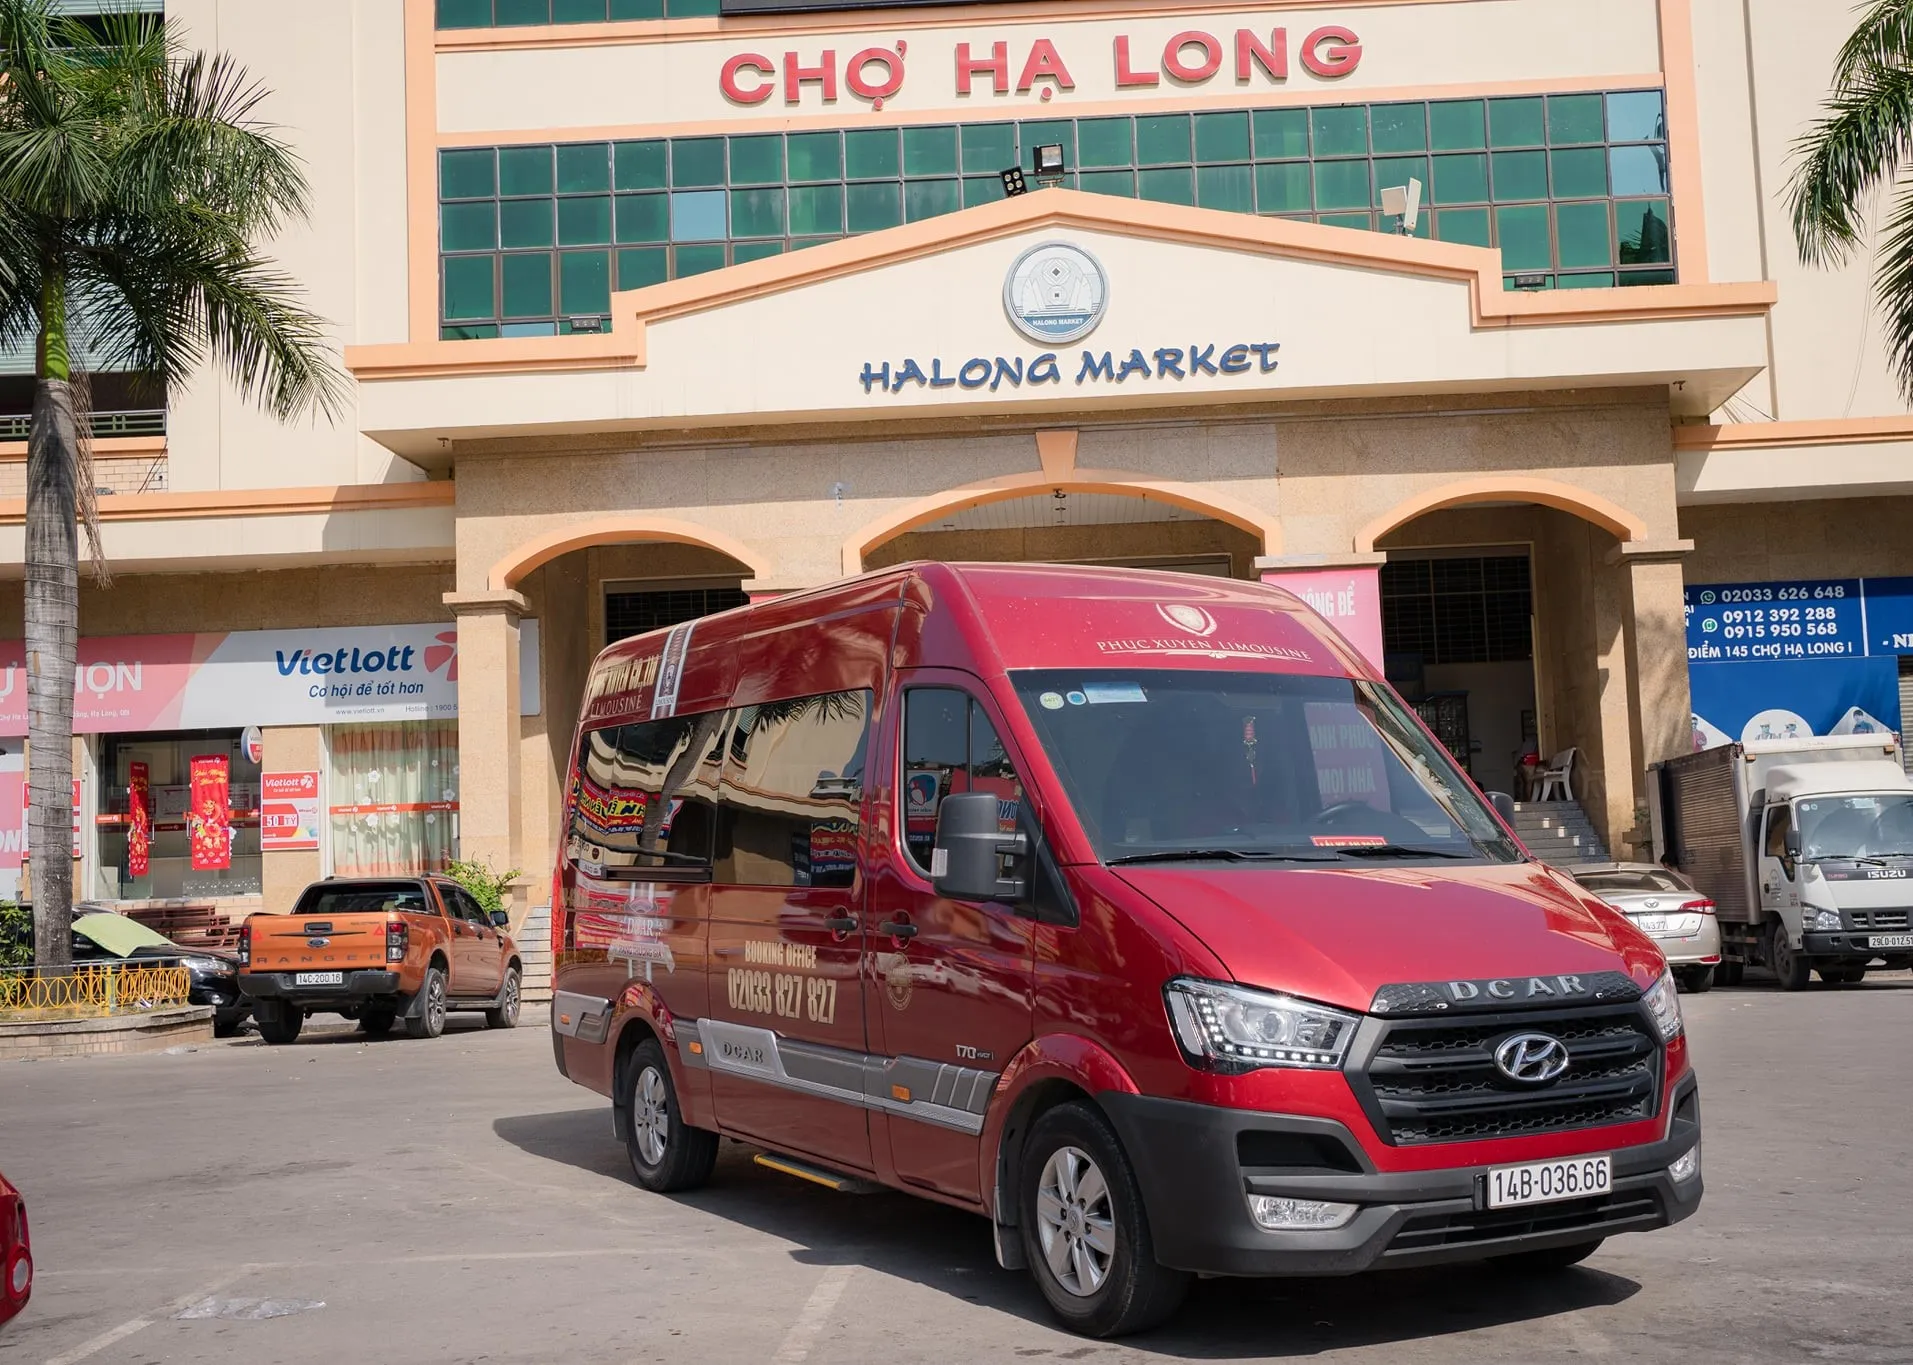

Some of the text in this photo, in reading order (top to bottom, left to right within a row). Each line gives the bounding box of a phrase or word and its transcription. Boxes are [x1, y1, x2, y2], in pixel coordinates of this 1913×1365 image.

[720, 25, 1363, 111] CHỢ HẠ LONG
[860, 343, 1281, 393] HALONG MARKET
[1721, 586, 1845, 602] 02033 626 648
[1722, 607, 1836, 623] 0912 392 288
[1724, 623, 1838, 639] 0915 950 568
[1096, 638, 1312, 660] PHUC XUYEN LIMOUSINE
[1687, 640, 1721, 659] ĐIỂM
[1725, 645, 1748, 657] 145
[1751, 643, 1781, 659] CHỢ
[1784, 643, 1804, 658] HẠ
[1807, 642, 1845, 654] LONG
[275, 645, 415, 676] Vietlott
[309, 679, 424, 699] Cơ hội để tốt hơn
[335, 707, 385, 716] www.vietlott.vn
[590, 695, 643, 718] LIMOUSINE
[265, 778, 299, 787] Vietlott
[1867, 870, 1906, 879] ISUZU
[256, 953, 381, 963] RANGER
[745, 940, 817, 969] BOOKING OFFICE
[298, 973, 341, 984] 14C-200.16
[1447, 974, 1585, 1001] DCAR
[728, 968, 838, 1024] 02033 827 827
[723, 1041, 764, 1064] DCAR
[956, 1044, 977, 1059] 170
[1495, 1158, 1608, 1203] 14B-036.66
